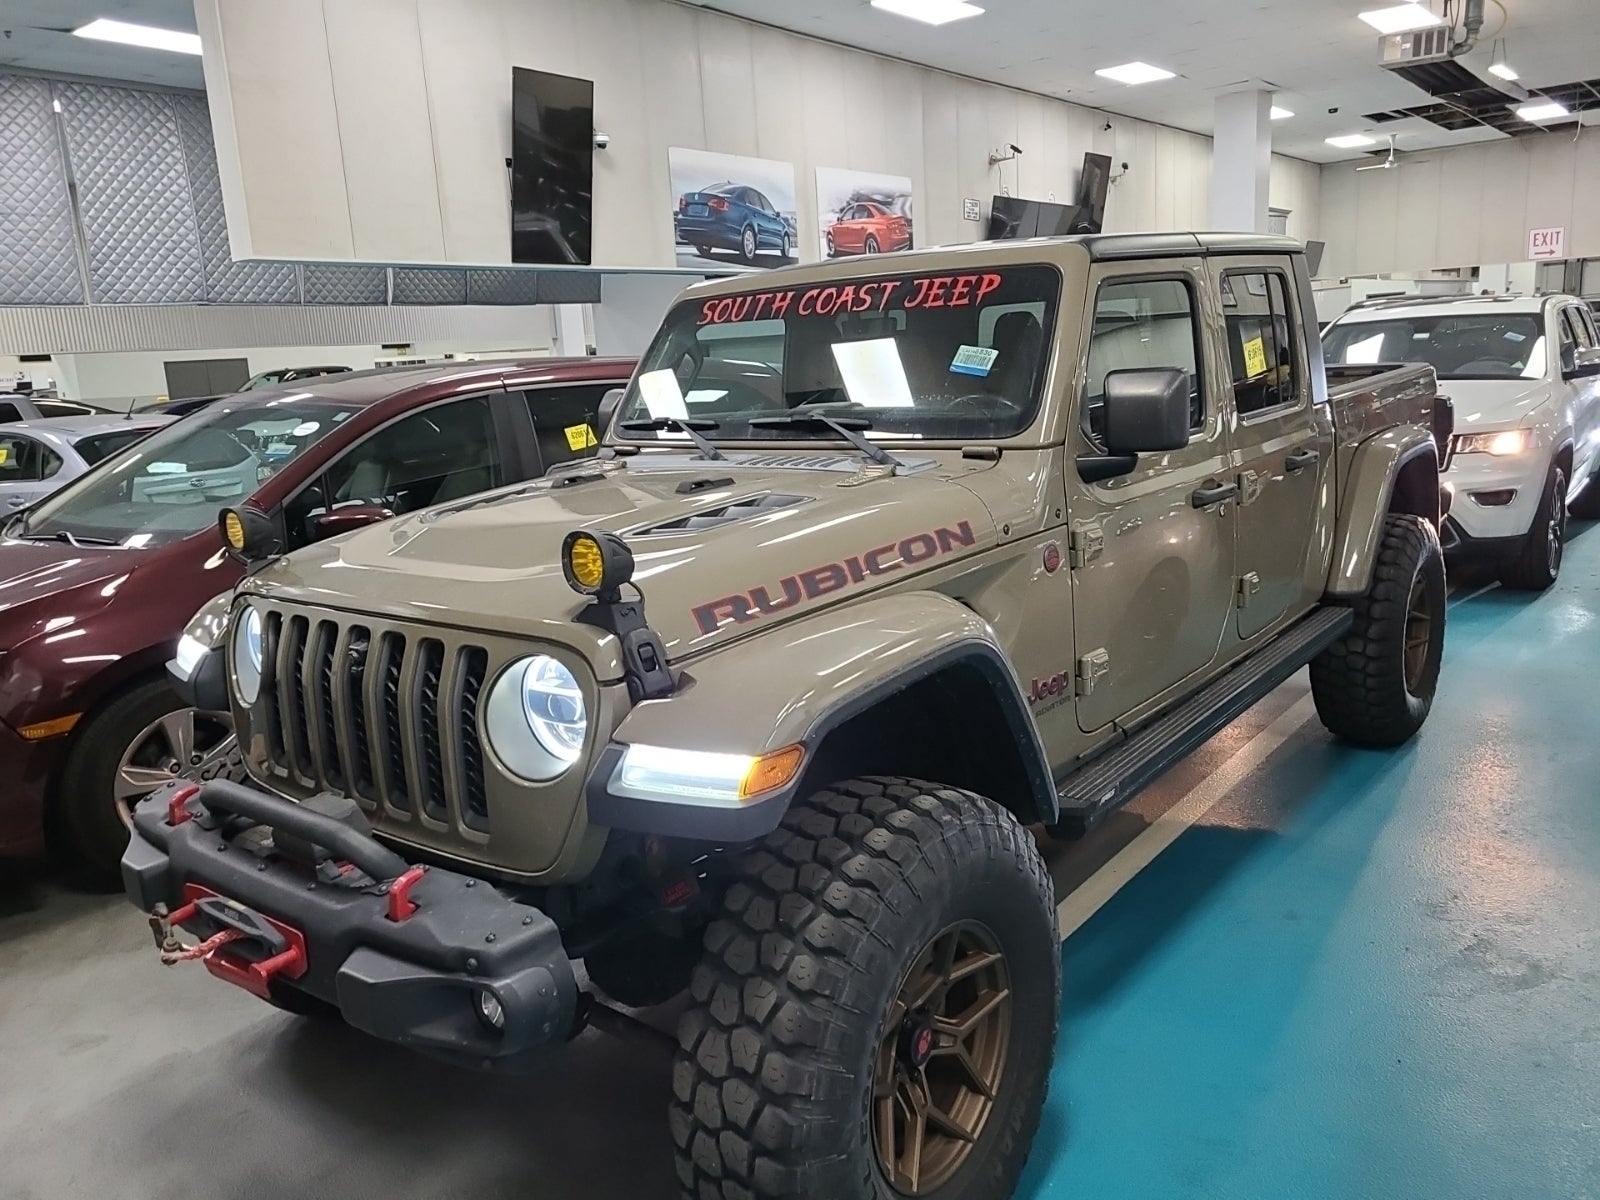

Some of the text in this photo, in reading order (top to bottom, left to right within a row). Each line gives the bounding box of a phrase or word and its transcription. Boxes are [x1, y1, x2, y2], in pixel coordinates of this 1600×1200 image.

[1532, 230, 1562, 247] EXIT
[696, 273, 1002, 326] SOUTH COAST JEEP
[690, 520, 977, 636] RUBICON
[1026, 669, 1070, 707] Jeep
